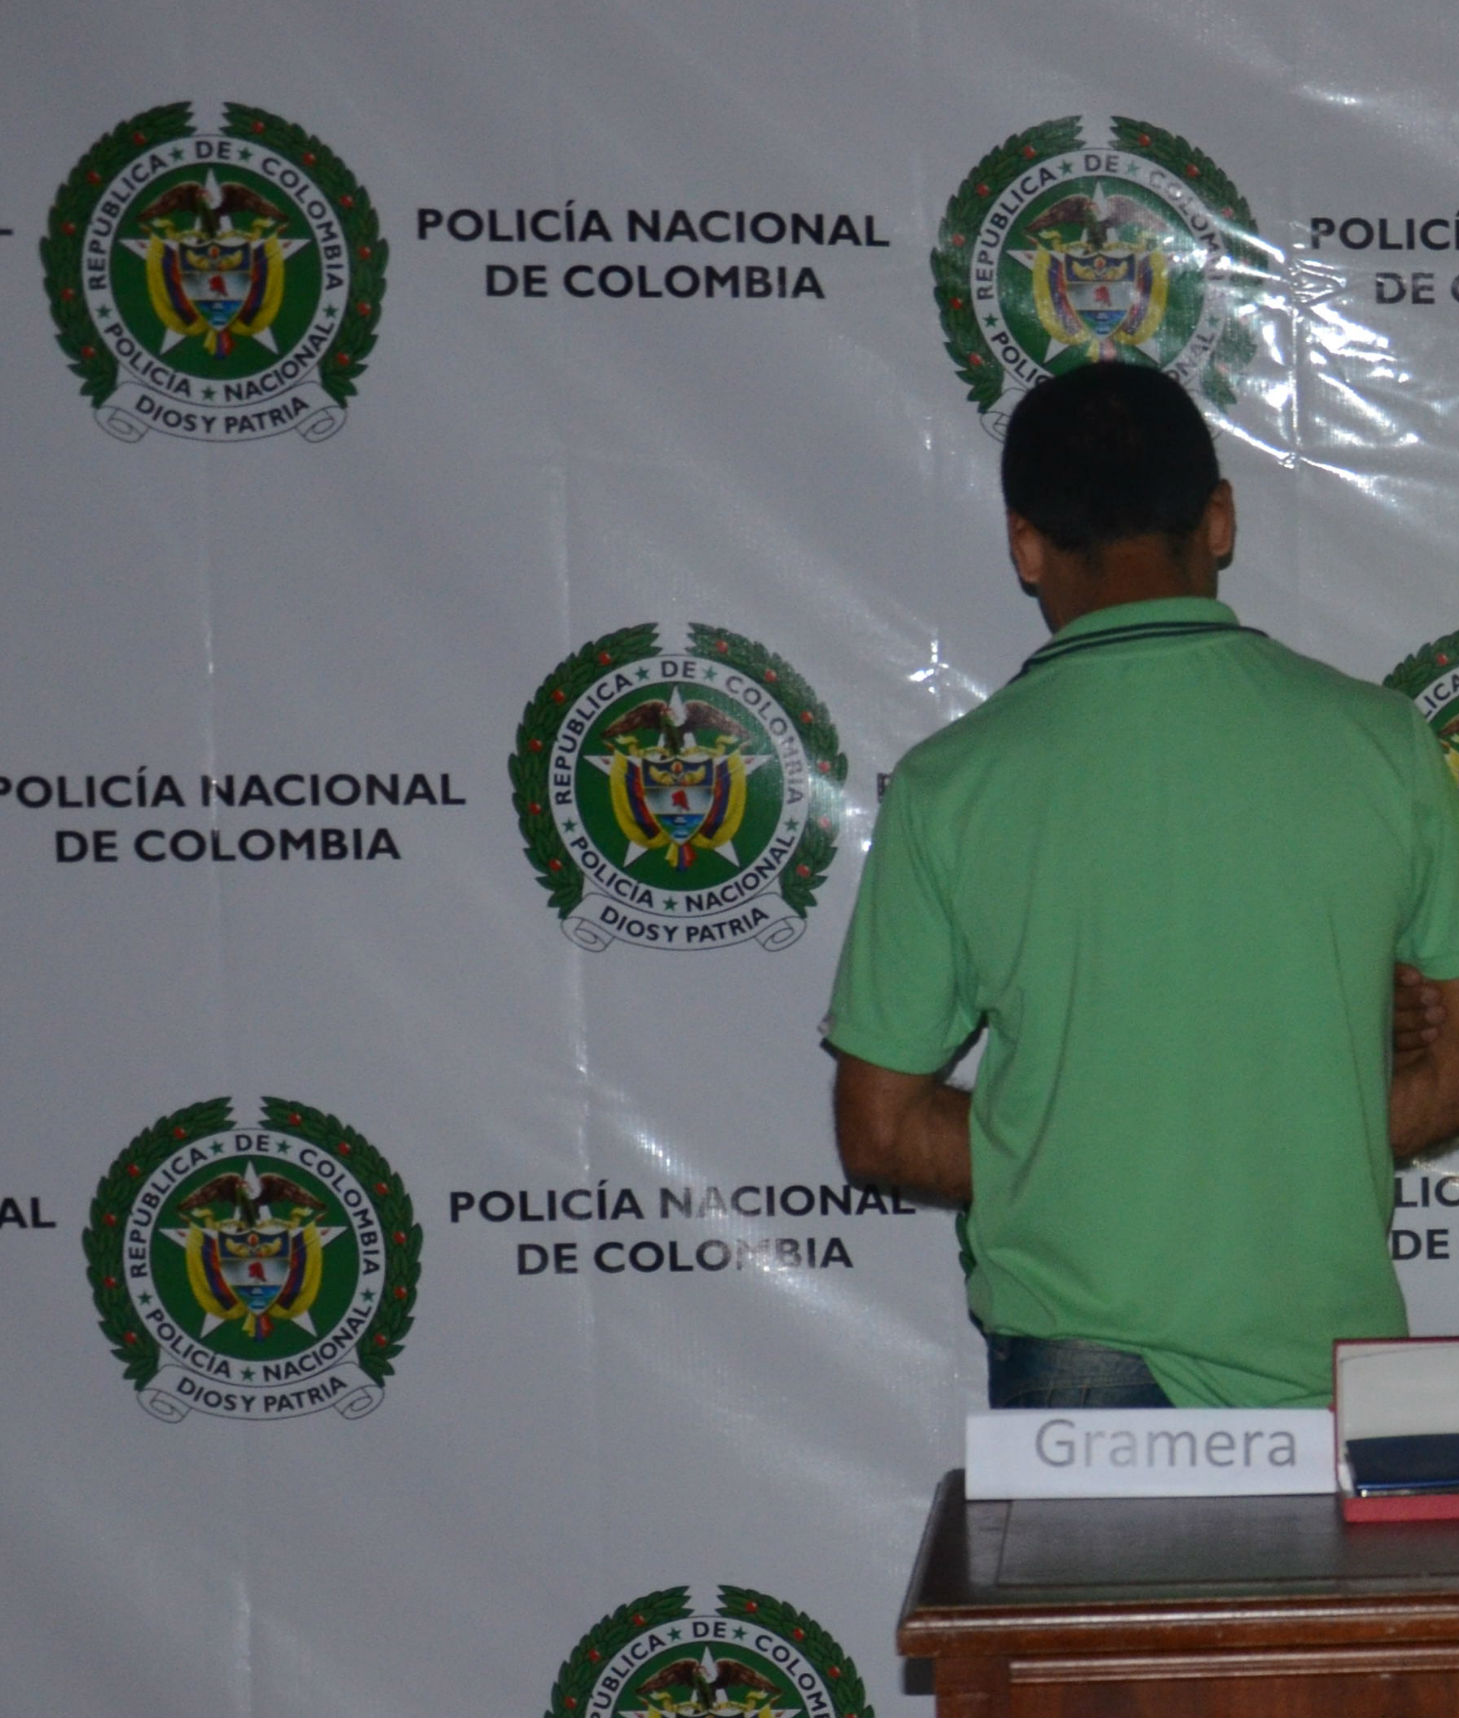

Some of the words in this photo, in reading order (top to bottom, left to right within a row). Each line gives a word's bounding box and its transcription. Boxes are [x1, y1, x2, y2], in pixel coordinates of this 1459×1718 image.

[1084, 155, 1119, 174] DE
[197, 141, 231, 160] DE
[259, 158, 343, 291] COLOMBIA
[418, 200, 612, 242] POLICÍA
[628, 210, 890, 247] NACIONAL
[486, 265, 548, 297] DE
[563, 265, 824, 299] COLOMBIA
[1376, 272, 1435, 304] DE
[223, 322, 335, 402] NACIONAL
[224, 397, 311, 434] PATRIA
[663, 660, 696, 679] DE
[723, 677, 803, 805] COLOMBIA
[201, 773, 466, 807] NACIONAL
[56, 830, 118, 862] DE
[134, 828, 401, 862] COLOMBIA
[685, 836, 795, 912] NACIONAL
[686, 907, 770, 943] PATRIA
[236, 1134, 270, 1153] DE
[298, 1150, 380, 1275] COLOMBIA
[450, 1180, 644, 1223] POLICÍA
[518, 1243, 578, 1275] DE
[593, 1237, 853, 1274] COLOMBIA
[1392, 1229, 1449, 1260] DE
[263, 1305, 373, 1382] NACIONAL
[264, 1376, 348, 1413] PATRIA
[1035, 1418, 1297, 1468] Gramera
[692, 1621, 726, 1639] DE
[754, 1635, 830, 1718] COLOM
